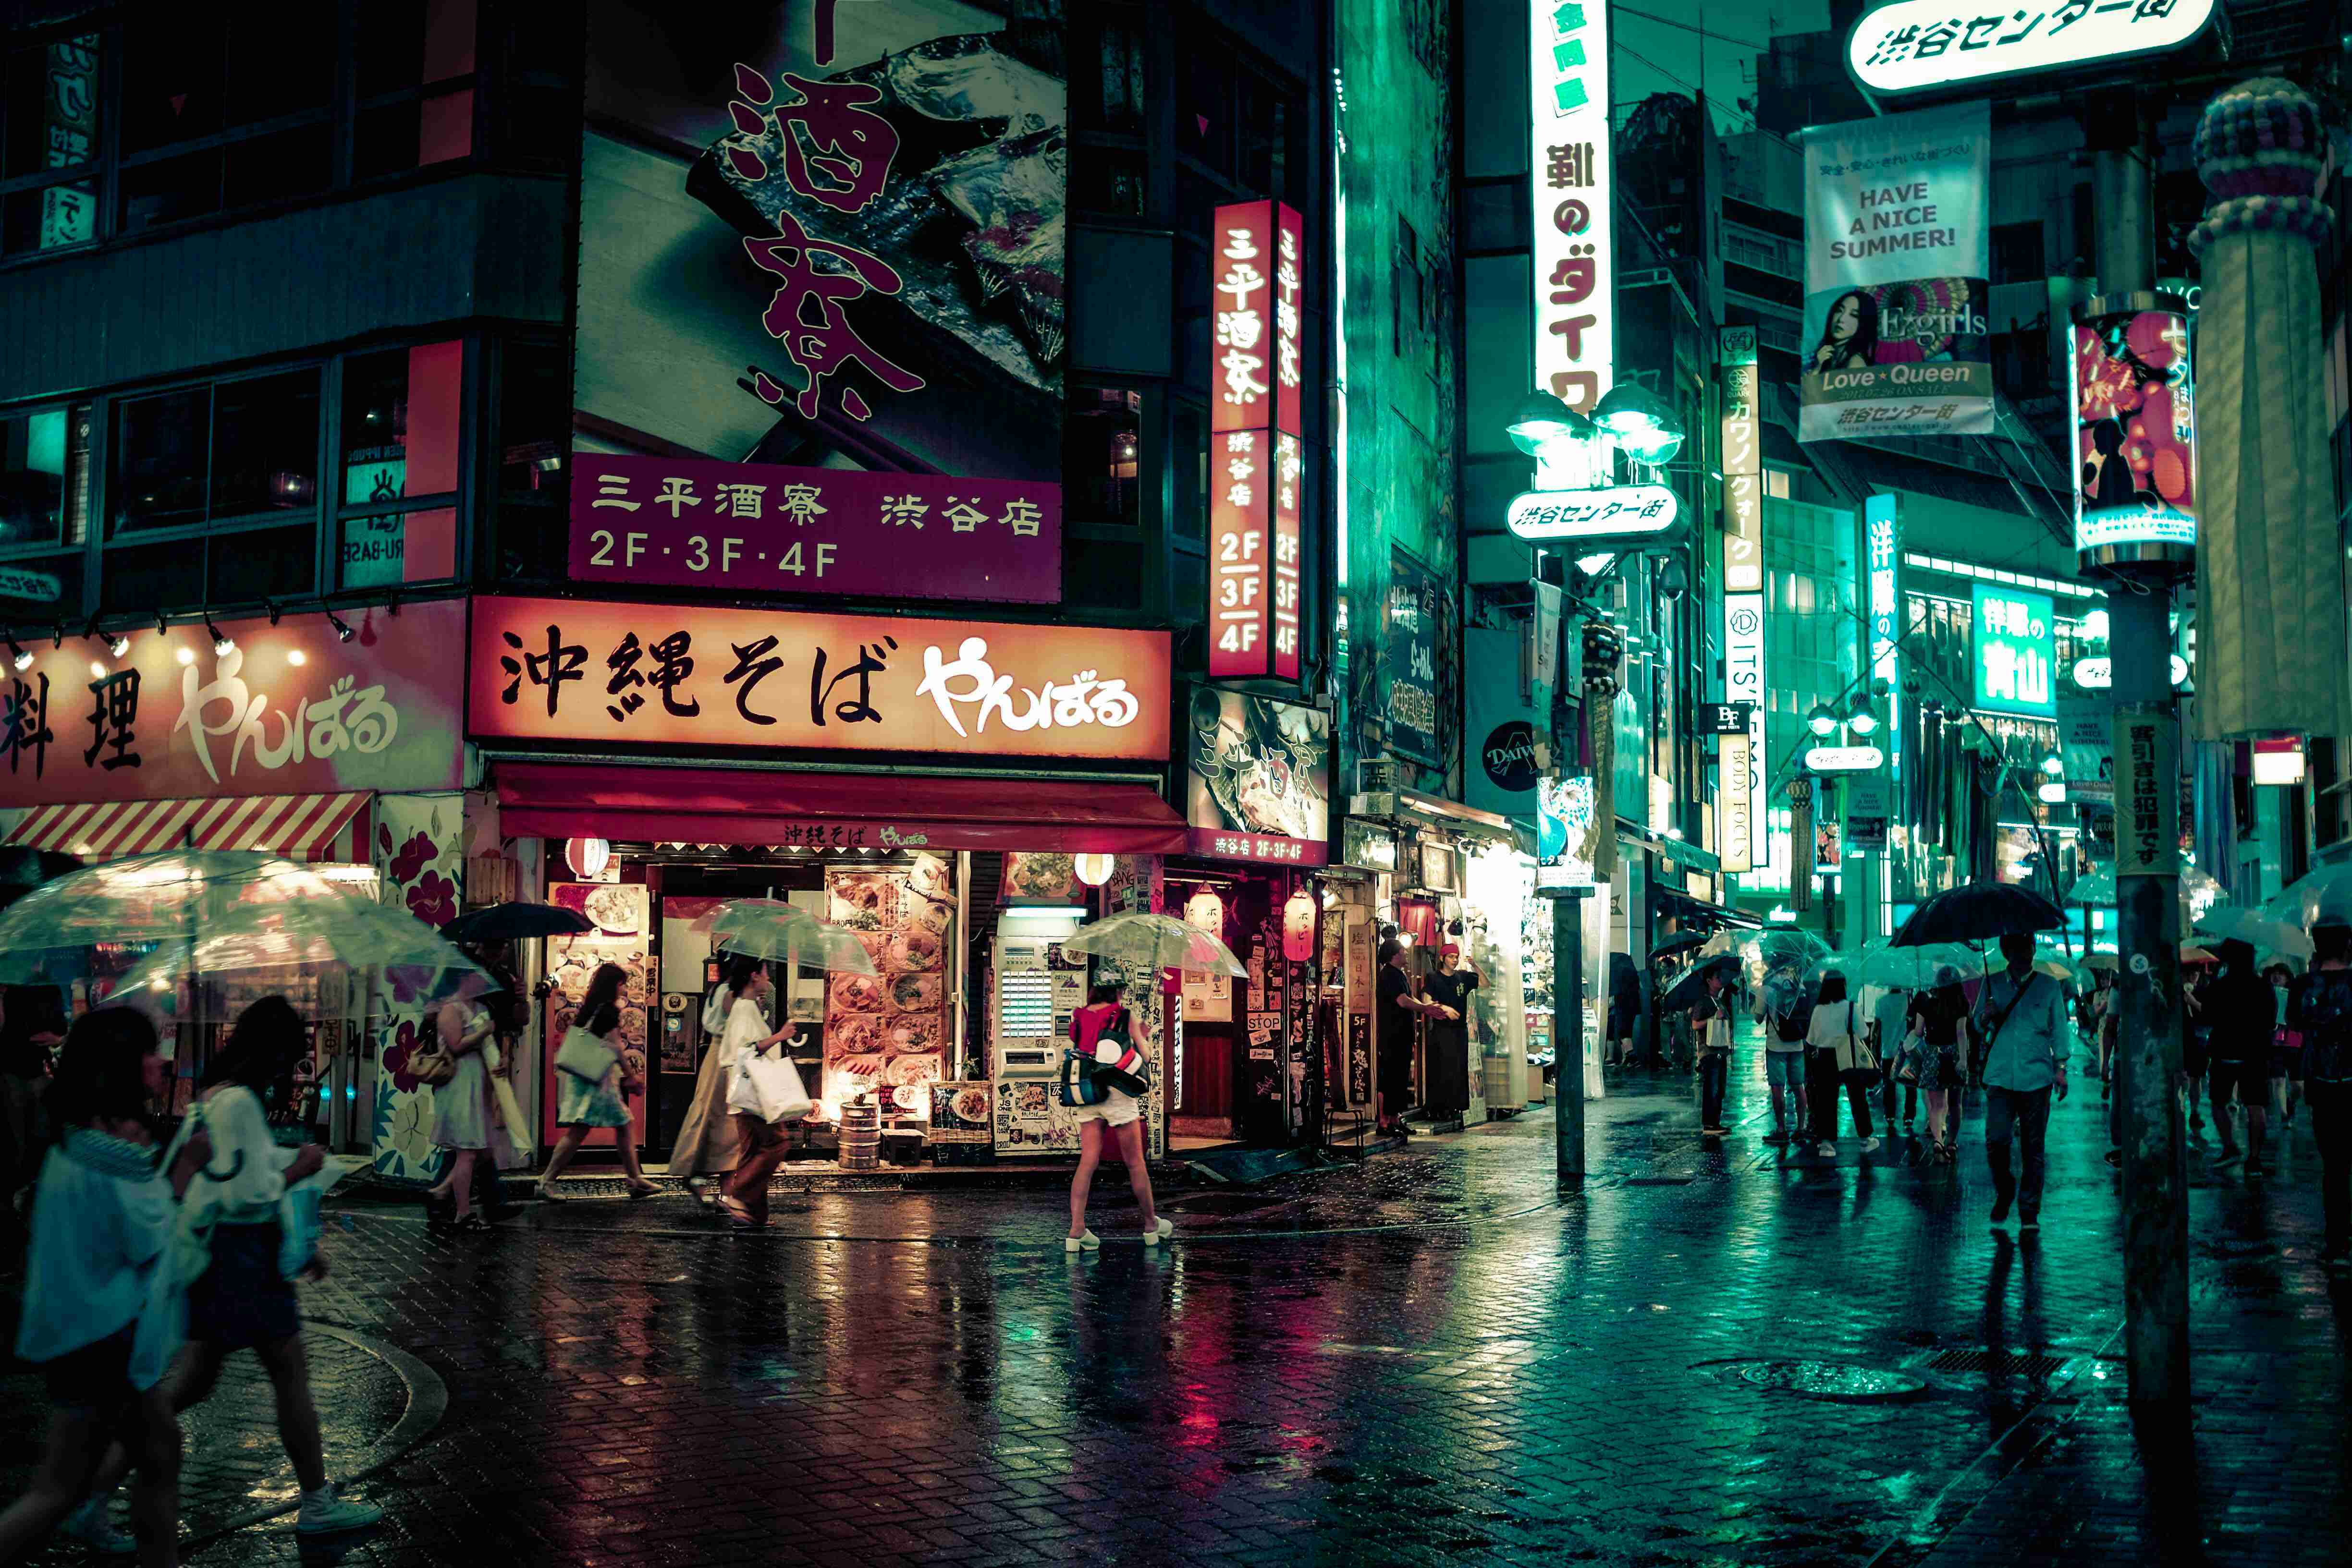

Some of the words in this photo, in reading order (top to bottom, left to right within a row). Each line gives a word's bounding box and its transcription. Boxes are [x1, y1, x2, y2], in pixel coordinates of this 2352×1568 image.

[1866, 0, 2177, 66] 渋谷センター街
[726, 0, 925, 420] 酒寮
[1860, 182, 1928, 208] HAVE
[1849, 218, 1866, 235] A
[1873, 205, 1936, 230] NICE
[1830, 228, 1955, 259] SUMMER!
[1217, 229, 1268, 405] 三平酒寮
[1823, 372, 1874, 391] Love
[1890, 365, 1970, 384] Queen
[1897, 385, 1915, 395] ON
[1917, 384, 1950, 394] SALE
[1838, 403, 1959, 425] 渋谷センター街
[1227, 432, 1254, 507] 渋谷店
[1729, 401, 1753, 561] カワノ・クォーク
[592, 474, 828, 525] 三平酒寮
[881, 494, 1042, 536] 渋谷店
[1515, 498, 1667, 526] 渋谷センター街
[1220, 531, 1260, 562] 2F
[1276, 532, 1297, 563] 2F
[1220, 577, 1260, 608] 3F
[1276, 579, 1297, 609] 3F
[1984, 598, 2045, 640] 洋服の
[1220, 624, 1259, 653] 4F
[1275, 624, 1296, 655] 4F
[501, 625, 900, 728] 沖縄そば
[915, 637, 1139, 739] やんばる
[1985, 644, 2048, 704] 青山
[174, 646, 398, 784] やんばる
[1717, 706, 1739, 726] BF
[1195, 730, 1321, 812] 三平酒寮
[1733, 751, 1746, 791] BODY
[2130, 724, 2159, 865] 客引きは犯罪です
[784, 824, 867, 845] 沖縄そば
[880, 826, 929, 847] やんばる
[1215, 838, 1250, 856] 渋谷店
[1298, 912, 1310, 953] ホッピー
[1249, 1018, 1280, 1029] STOP
[1353, 1016, 1366, 1026] 5F
